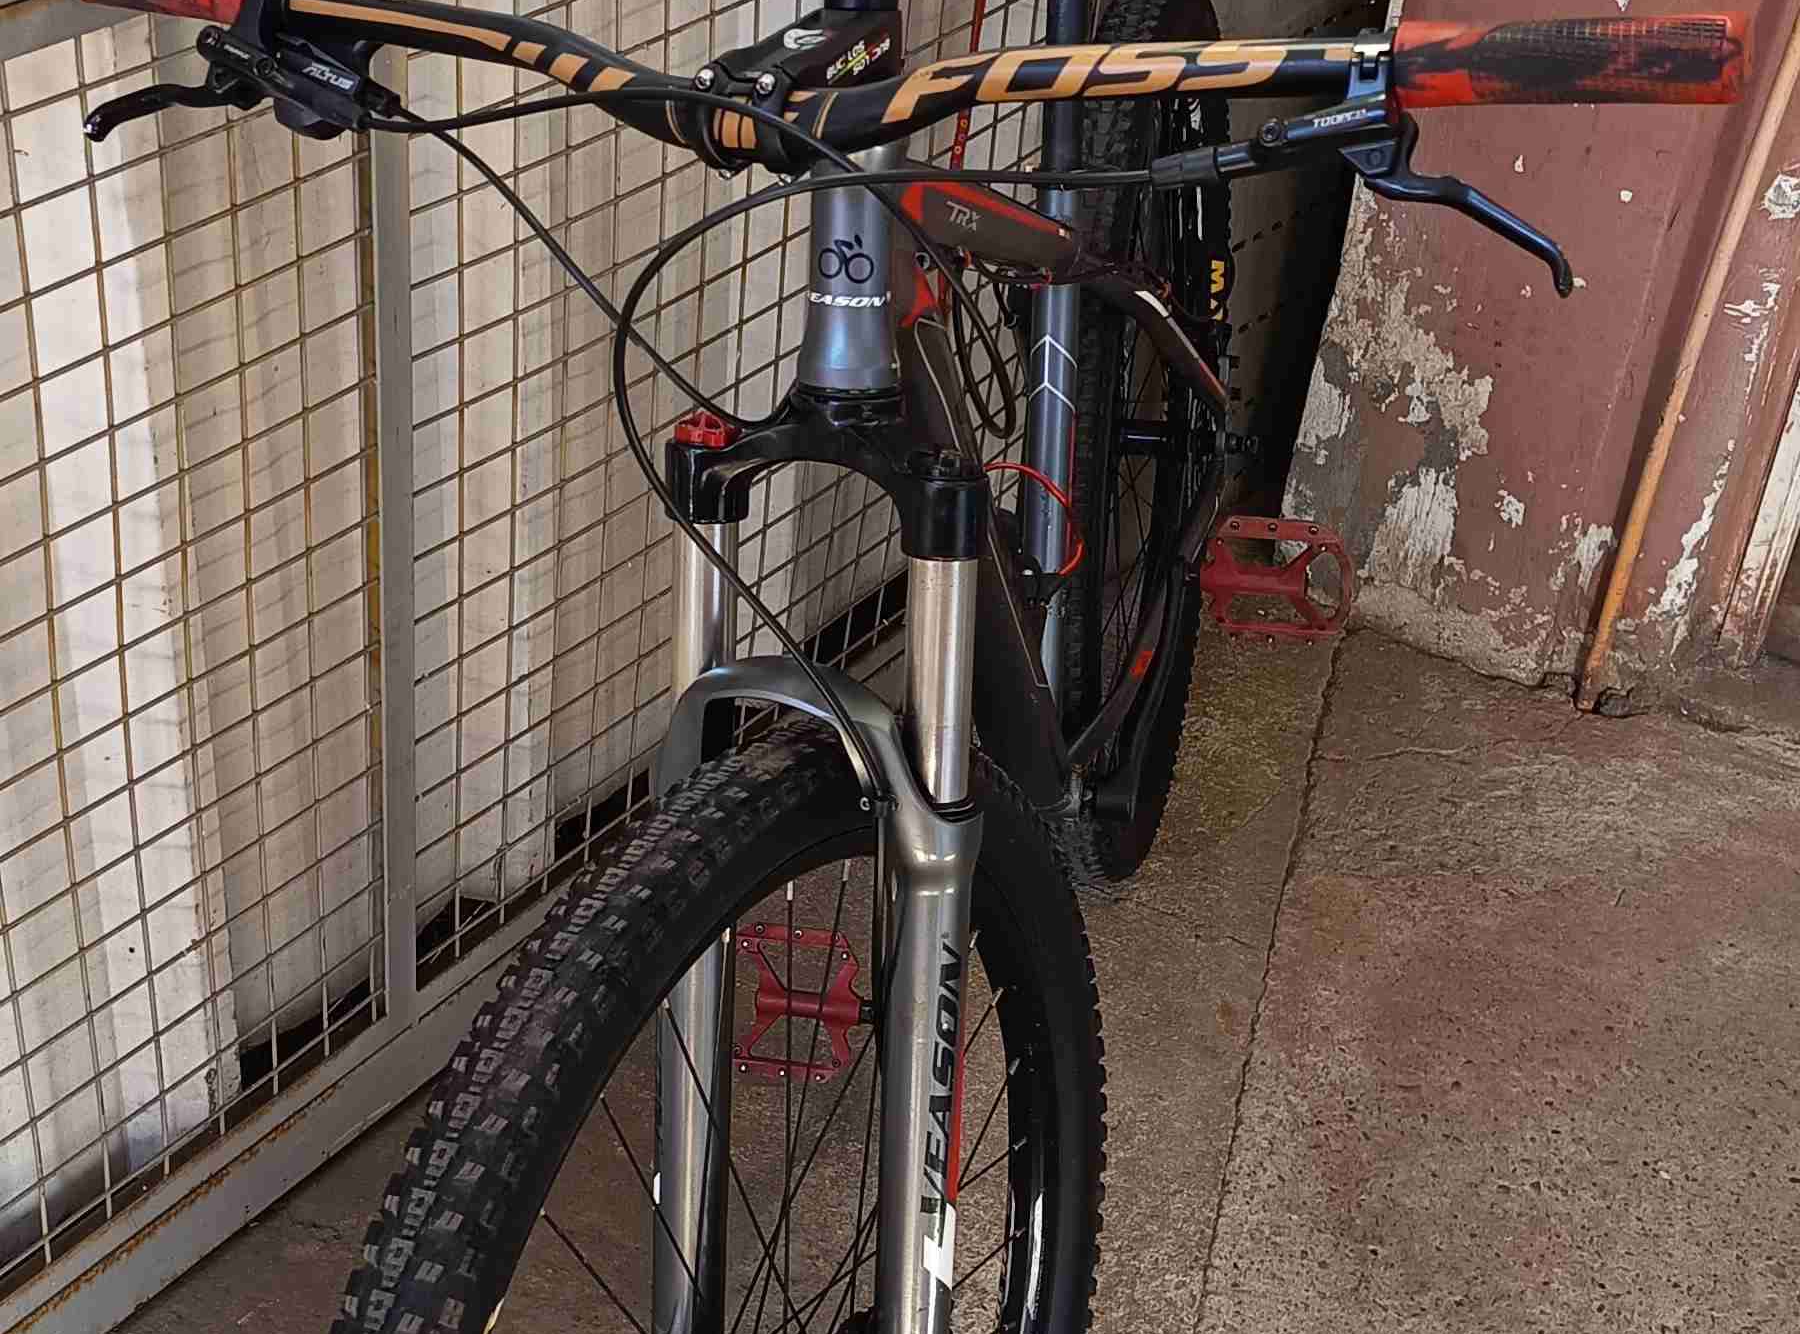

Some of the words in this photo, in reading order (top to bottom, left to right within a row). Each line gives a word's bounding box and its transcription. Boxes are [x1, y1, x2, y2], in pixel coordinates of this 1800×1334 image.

[302, 64, 354, 90] ALTUS
[881, 43, 1287, 124] FOSS
[808, 291, 889, 308] EASON
[919, 941, 962, 1219] VEASON
